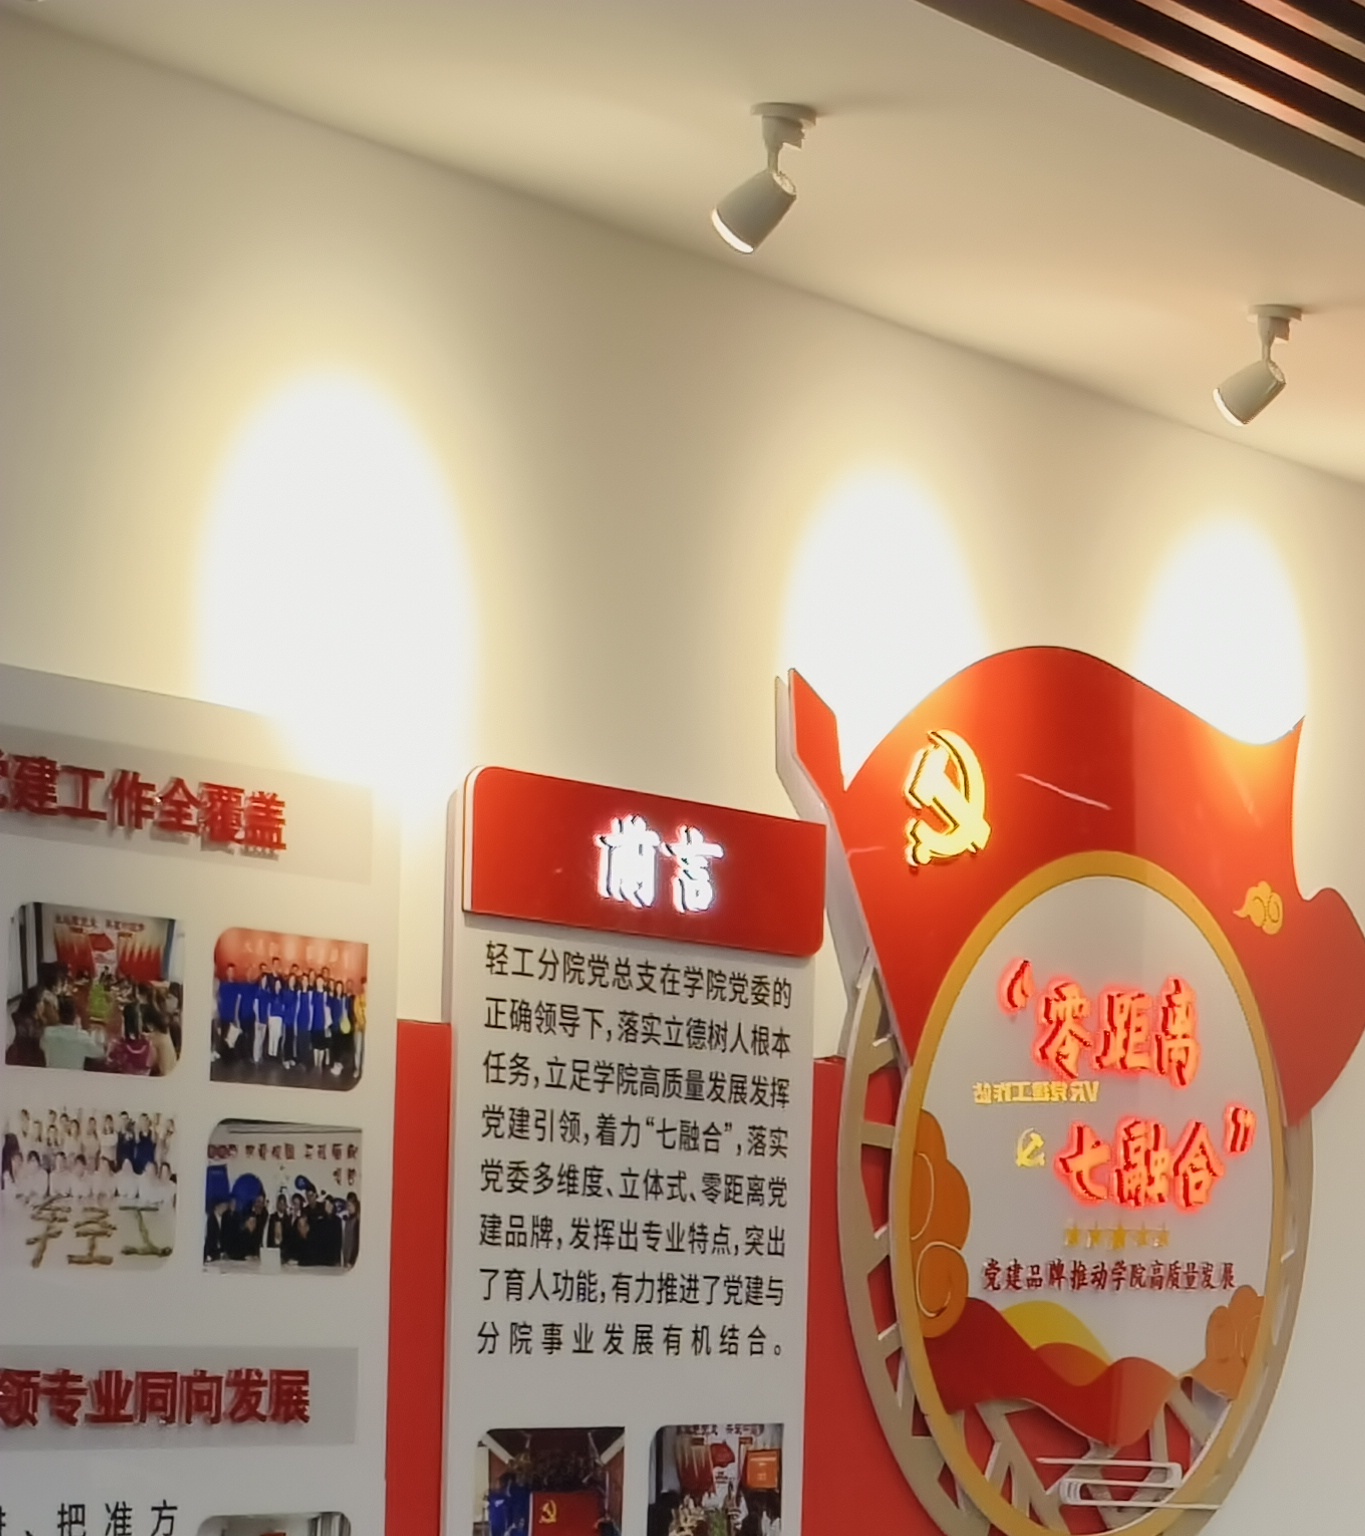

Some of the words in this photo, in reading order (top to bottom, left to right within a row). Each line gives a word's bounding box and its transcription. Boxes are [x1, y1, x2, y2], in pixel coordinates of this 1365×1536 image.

[0, 750, 286, 850] 建工作全覆盖
[485, 940, 792, 1009] 轻工分院党总支在学院党委的
[480, 1160, 788, 1208] 党委多维度、立体式、零距离党
[983, 1257, 1236, 1291] 党建品牌推动学院高质量发展
[477, 1321, 782, 1357] 分院事业发展有机结合。
[0, 1367, 310, 1427] 领专业同向发展
